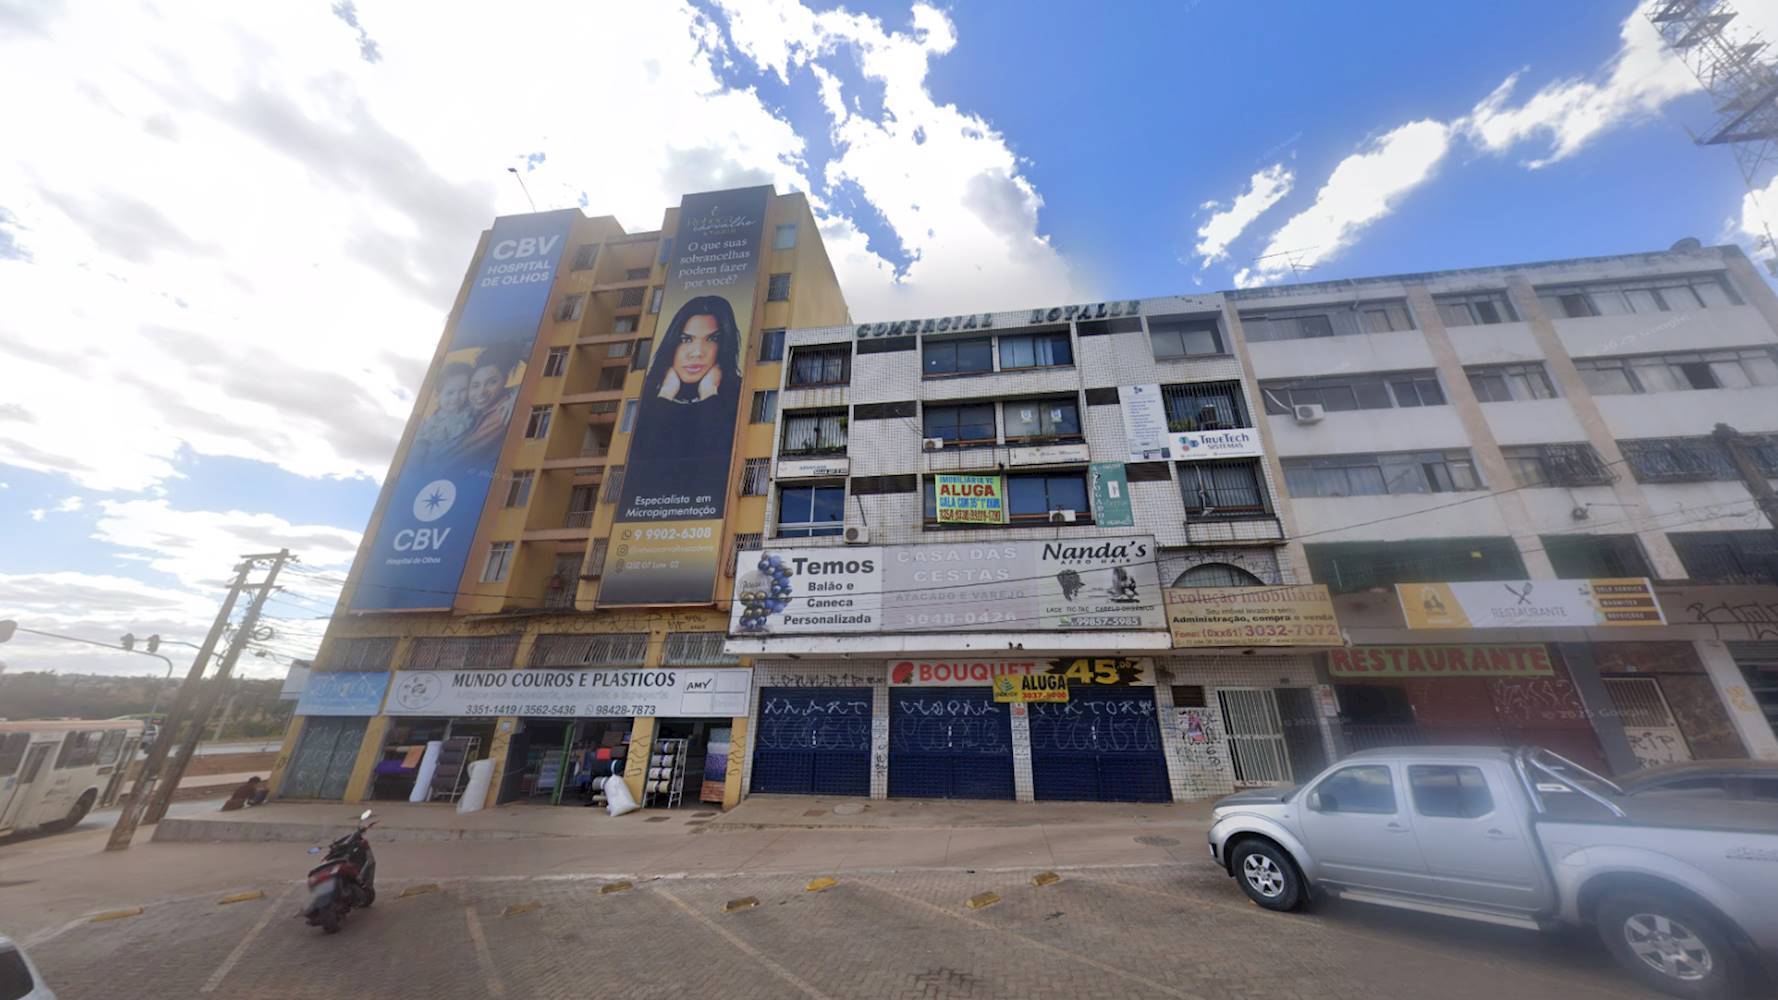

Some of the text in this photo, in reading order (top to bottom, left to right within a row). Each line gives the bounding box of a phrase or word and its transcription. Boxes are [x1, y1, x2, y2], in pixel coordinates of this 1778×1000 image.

[493, 235, 560, 260] CBV
[688, 239, 748, 253] O que suas
[680, 250, 751, 265] sobrancelhas
[487, 260, 552, 275] HOSPITAL
[679, 262, 748, 279] podem fazer
[481, 271, 550, 288] DE OLHOS
[684, 280, 705, 290] por
[856, 312, 994, 338] COMERCIAL
[940, 484, 996, 496] ALUGA
[635, 494, 712, 507] Especialista em
[625, 506, 717, 518] Micropigmentação
[393, 527, 452, 552] CBV
[645, 526, 713, 541] 9902-6308
[897, 547, 1018, 563] CASA DAS
[1042, 540, 1147, 561] Nanda's
[792, 557, 875, 576] Temos
[913, 568, 1010, 583] CESTAS
[808, 581, 843, 591] Balão
[806, 597, 854, 608] Caneca
[896, 592, 957, 602] ATACADO
[972, 590, 1025, 599] VAREJO
[1168, 590, 1238, 607] Evolução
[783, 612, 872, 625] Personalizada
[1173, 615, 1250, 624] Administração,
[1252, 615, 1292, 623] compra
[1490, 607, 1568, 618] RESTAURANTE
[1245, 624, 1337, 637] 3032-7072
[1331, 645, 1550, 672] RESTAURANTE
[919, 661, 1036, 682] BOUQUET
[452, 673, 507, 688] MUNDO
[511, 672, 575, 688] COUROS
[579, 673, 588, 687] E
[686, 678, 713, 690] AMY
[1022, 675, 1066, 690] ALUGA
[465, 704, 518, 714] 3351-1419
[525, 704, 577, 714] 3562-5436
[595, 703, 657, 715] 98428-7873
